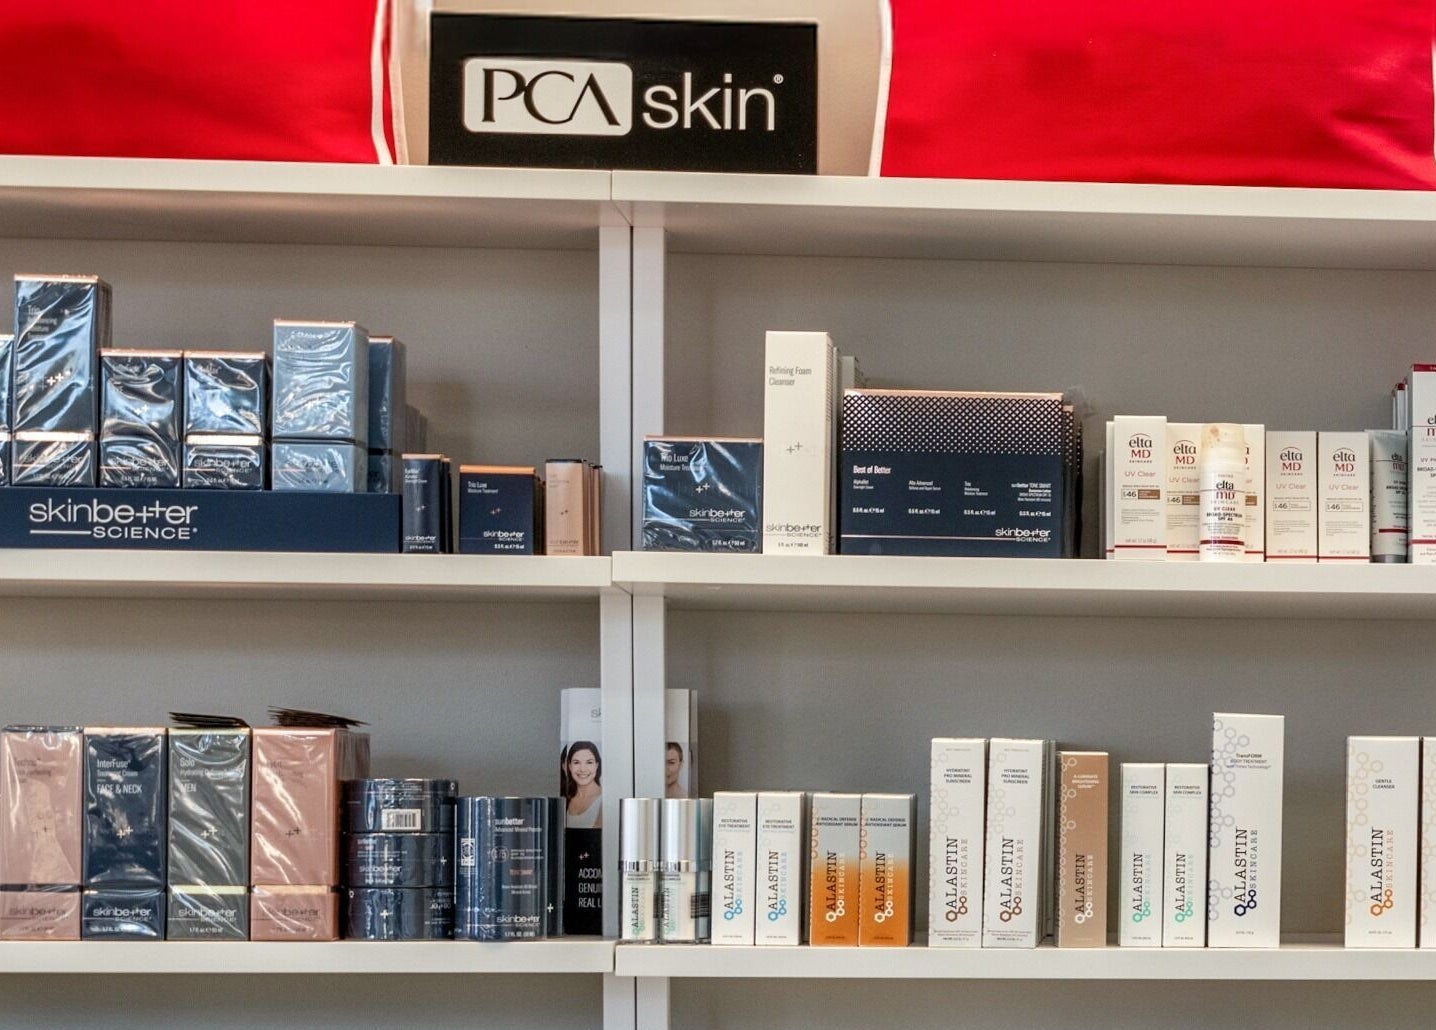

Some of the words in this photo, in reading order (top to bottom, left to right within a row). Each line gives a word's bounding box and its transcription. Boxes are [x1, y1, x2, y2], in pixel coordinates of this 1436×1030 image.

[482, 68, 620, 126] PCA
[796, 367, 812, 375] Foam
[769, 377, 795, 386] Cleanser
[1129, 436, 1152, 448] elta
[1131, 449, 1151, 459] MD
[853, 466, 866, 474] Best
[867, 466, 873, 474] of
[874, 466, 891, 474] Better
[30, 499, 198, 523] skinbetter
[1235, 828, 1247, 902] ALASTIN
[1250, 830, 1258, 888] SKINCARE
[1371, 828, 1383, 902] ALASTIN
